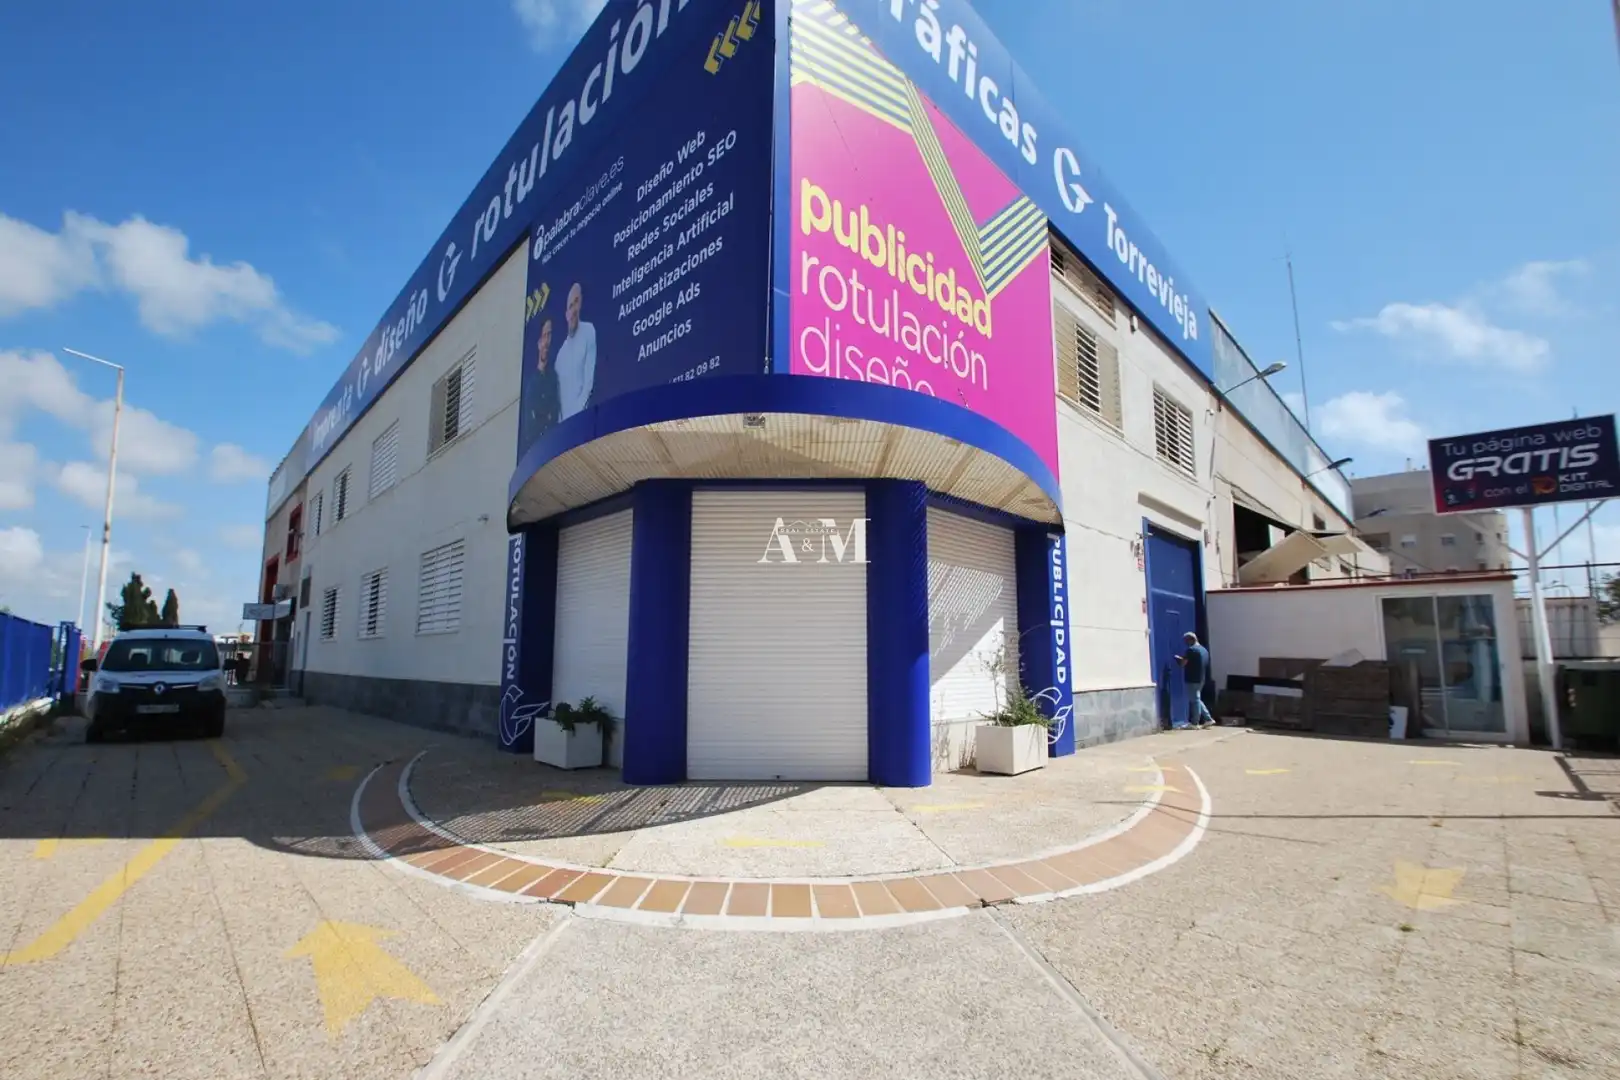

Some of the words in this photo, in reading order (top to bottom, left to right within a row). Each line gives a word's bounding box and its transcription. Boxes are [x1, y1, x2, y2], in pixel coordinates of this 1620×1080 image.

[543, 156, 624, 250] palabraclave.es
[613, 162, 704, 248] Posicionamiento
[707, 130, 737, 166] SEO
[636, 161, 674, 202] Diseño
[677, 130, 705, 164] Web
[612, 244, 673, 299] Inteligencia
[677, 192, 734, 250] Artificial
[627, 227, 660, 261] Redes
[662, 182, 714, 232] Sociales
[801, 178, 992, 339] publicidad
[618, 236, 723, 321] Automatizaciones
[632, 302, 673, 337] Google
[676, 281, 701, 309] Ads
[1104, 202, 1198, 341] Torrevieja
[374, 290, 428, 376] diseño
[638, 318, 692, 362] Anuncios
[709, 355, 720, 370] 82
[801, 250, 988, 390] rotulación
[1441, 442, 1466, 456] Tu
[1472, 431, 1547, 454] página
[1552, 423, 1602, 442] web
[1558, 472, 1588, 482] KIT
[1559, 479, 1614, 492] DIGITAL
[503, 532, 522, 680] ROTULACIÓN
[1047, 532, 1066, 684] PUBLICIDAD
